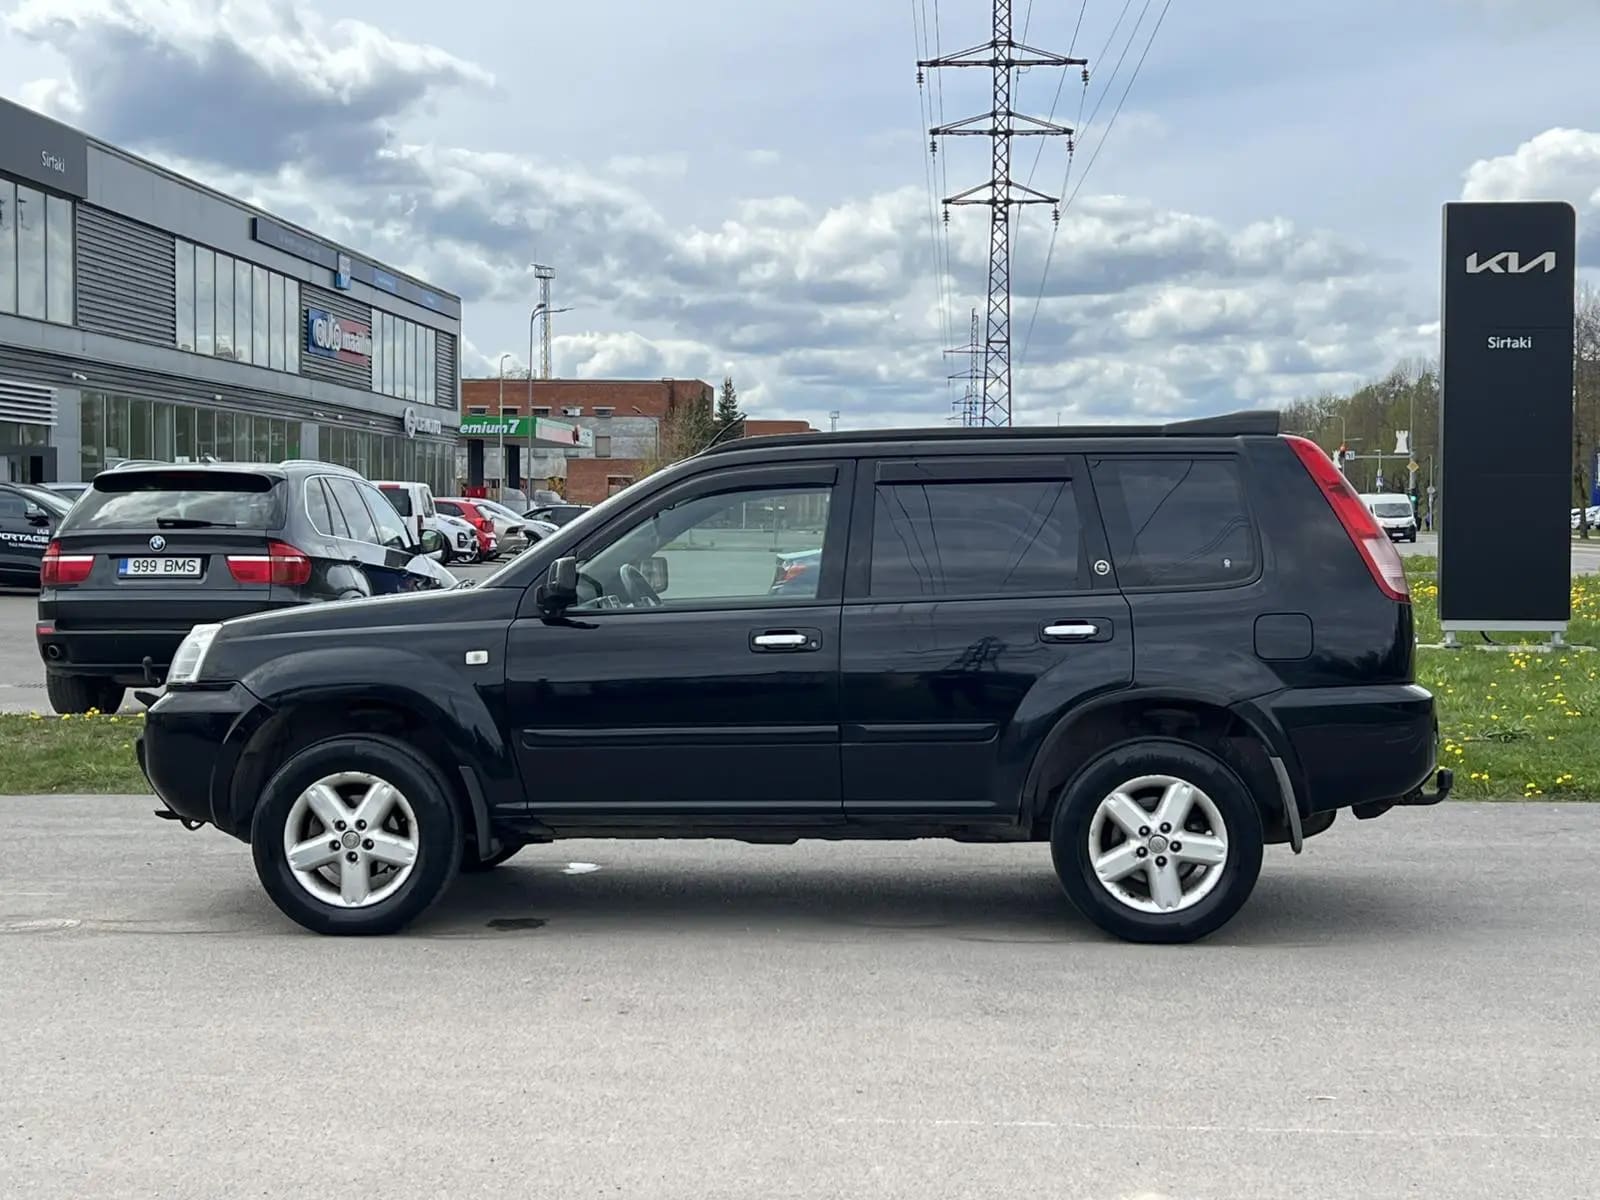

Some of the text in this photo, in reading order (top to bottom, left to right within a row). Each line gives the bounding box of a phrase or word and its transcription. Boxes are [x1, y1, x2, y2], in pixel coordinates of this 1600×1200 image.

[41, 150, 65, 173] Sirtaki
[1466, 251, 1556, 273] KIA
[313, 313, 342, 352] auto
[1488, 336, 1532, 349] Sirtaki
[0, 533, 50, 543] ORTAGE
[132, 559, 197, 573] 999 BMS
